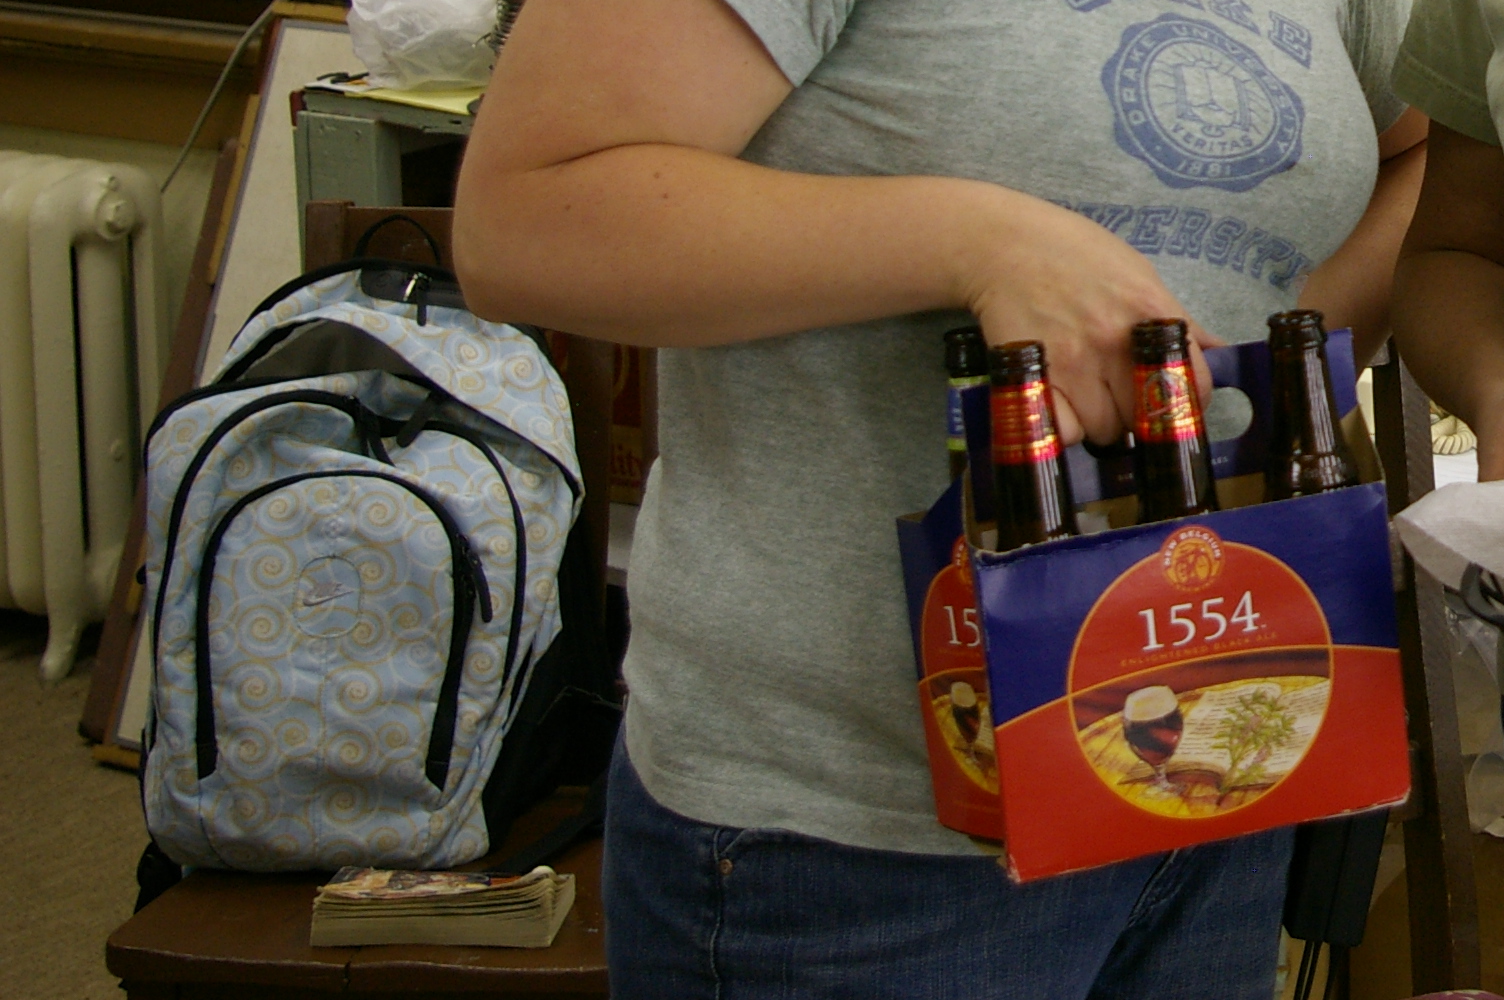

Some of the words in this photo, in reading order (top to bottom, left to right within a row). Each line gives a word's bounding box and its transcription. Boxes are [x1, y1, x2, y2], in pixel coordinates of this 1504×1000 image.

[1121, 34, 1159, 127] DRAKE
[1172, 24, 1297, 155] UNIVERSITY
[1171, 122, 1256, 154] VERITAS
[1176, 157, 1233, 179] 1881
[1048, 200, 1317, 292] VERSITY
[1164, 540, 1178, 567] NEW
[1178, 528, 1222, 560] BELGIUM
[943, 605, 981, 648] 15
[1138, 590, 1262, 651] 1554
[1213, 637, 1251, 651] BLACK
[1255, 631, 1279, 642] ALE
